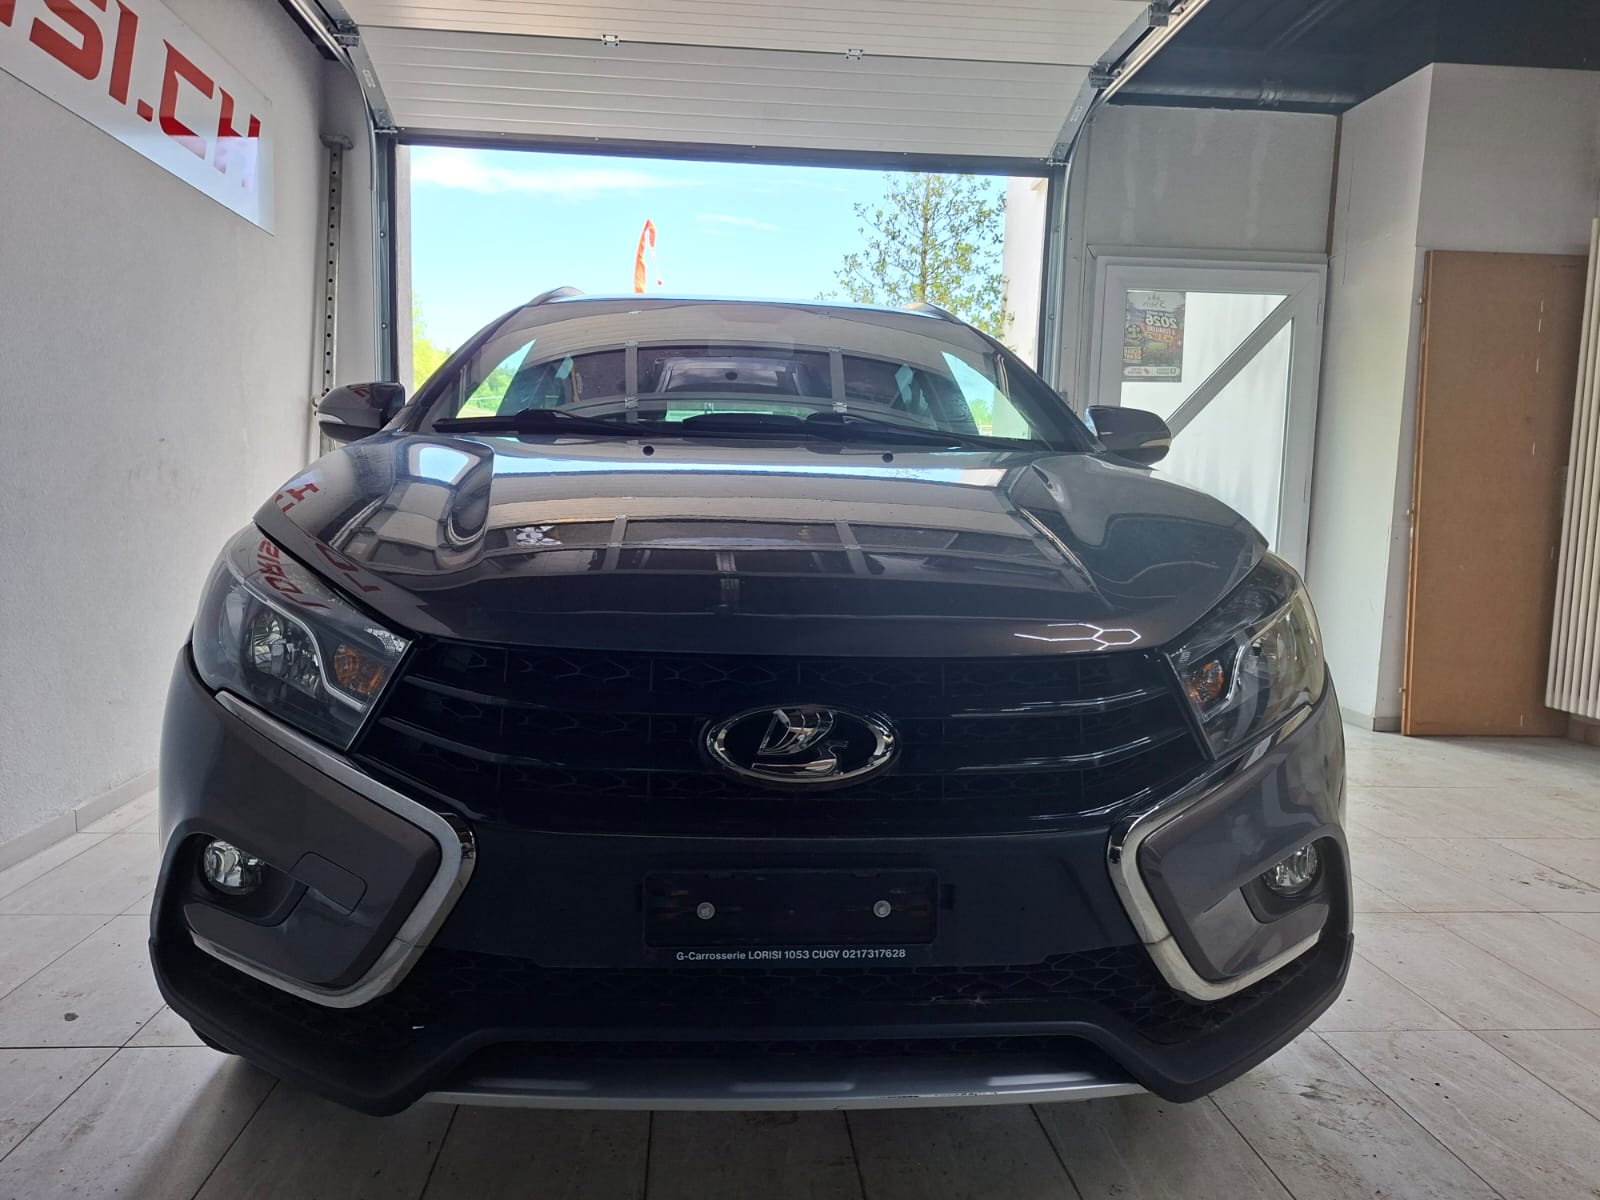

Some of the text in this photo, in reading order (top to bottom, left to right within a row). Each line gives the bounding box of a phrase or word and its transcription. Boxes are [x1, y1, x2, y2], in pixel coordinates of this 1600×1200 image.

[0, 0, 261, 190] SI.CH
[676, 949, 906, 961] G-Carrosserie LORISI 1053 CUGY 0217317628
